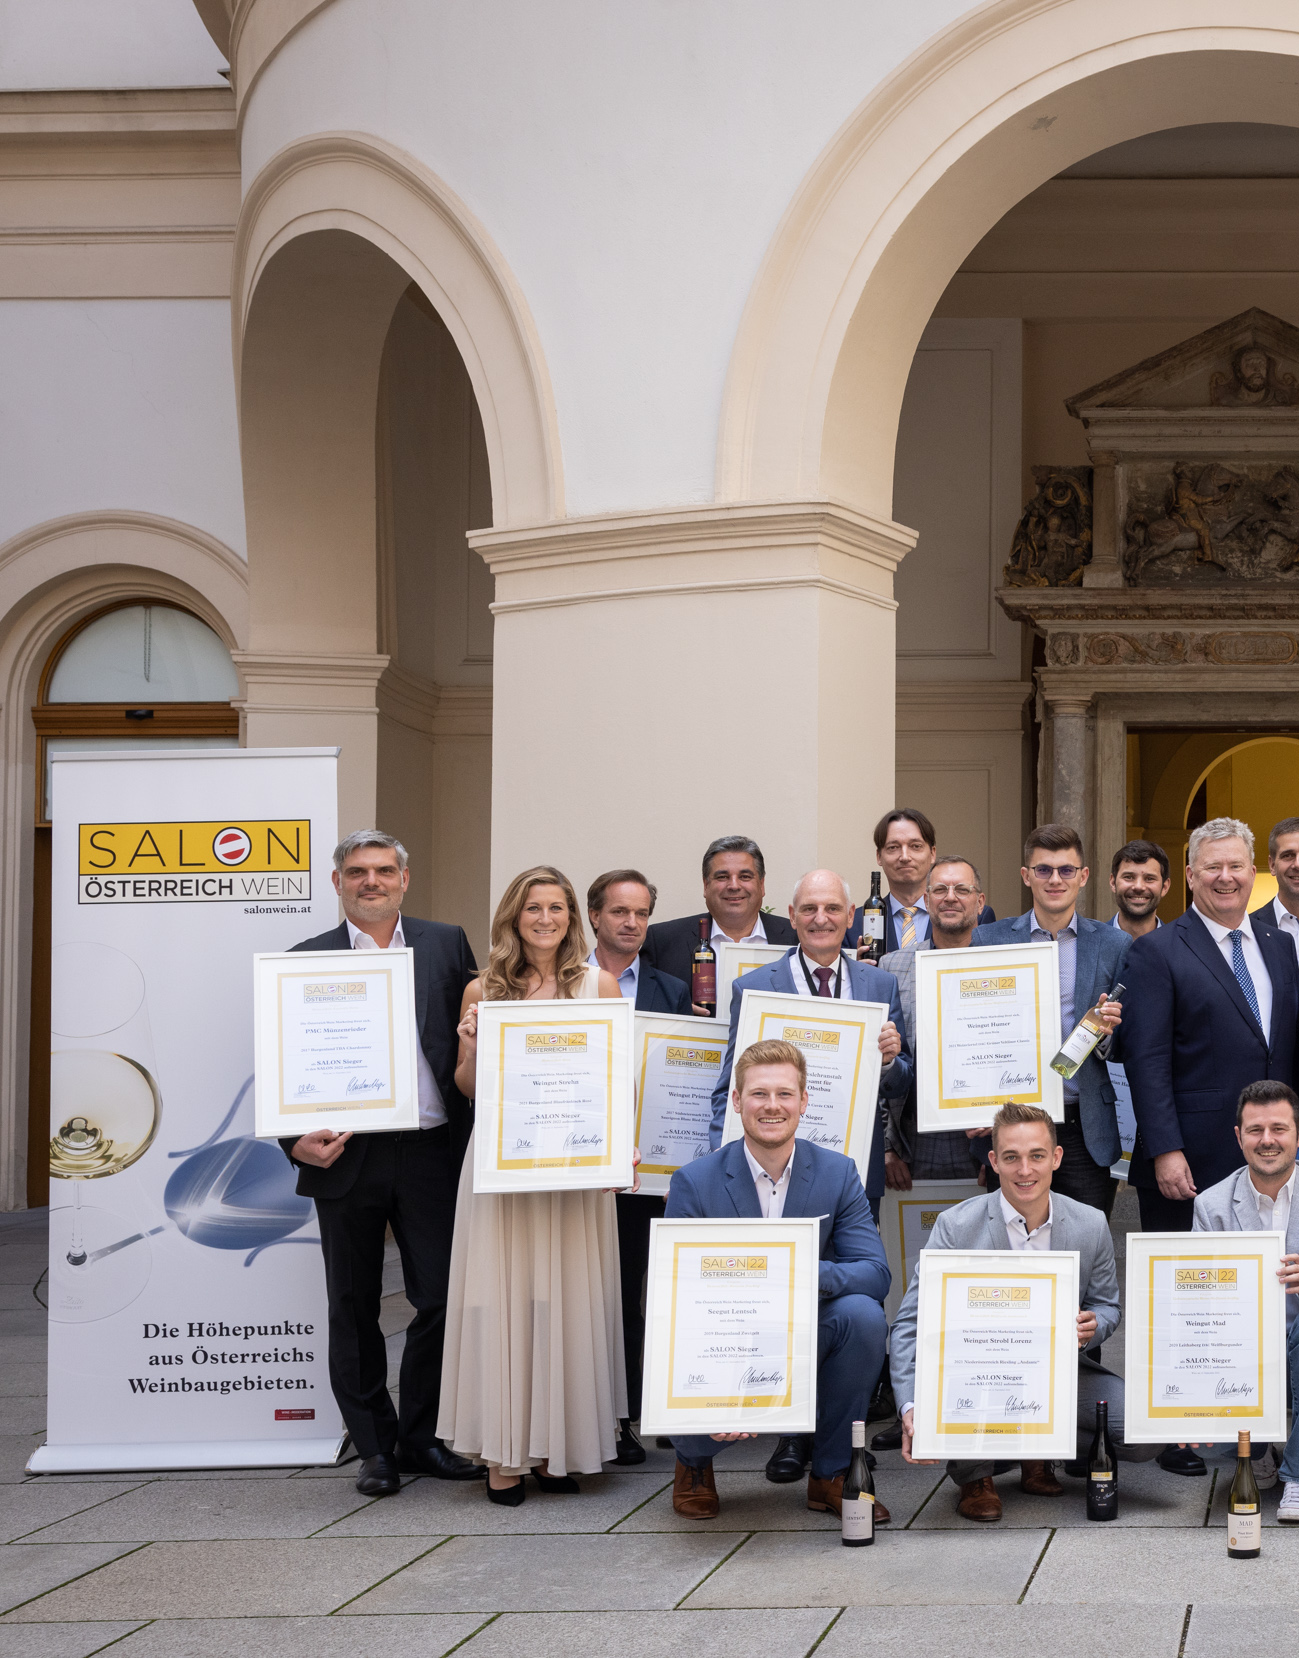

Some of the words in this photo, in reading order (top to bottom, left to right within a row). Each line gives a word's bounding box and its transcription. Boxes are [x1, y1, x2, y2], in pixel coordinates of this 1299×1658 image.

[89, 827, 300, 867] SALON
[85, 877, 233, 898] ÖSTERREICH
[241, 878, 303, 895] WEIN
[244, 905, 311, 914] salonwein.at
[306, 984, 346, 995] SALON
[350, 984, 364, 993] 22
[961, 979, 998, 990] SALON
[1001, 978, 1014, 987] 22
[527, 1036, 568, 1045] SALON
[571, 1035, 584, 1044] 22
[785, 1029, 820, 1041] SALON
[824, 1033, 838, 1043] 22
[667, 1048, 704, 1060] SALON
[706, 1053, 719, 1061] 22
[666, 1060, 702, 1068] ÖSTERREICH
[703, 1258, 746, 1269] SALON
[750, 1258, 765, 1268] 22
[1177, 1271, 1217, 1281] SALON
[1220, 1270, 1234, 1280] 22
[970, 1289, 1010, 1299] SALON
[1014, 1289, 1028, 1299] 22
[143, 1323, 179, 1338] Die
[187, 1320, 314, 1340] Höhepunkte
[149, 1352, 184, 1366] aus
[192, 1346, 314, 1365] Österreichs
[128, 1376, 315, 1394] Weinbaugebieten.
